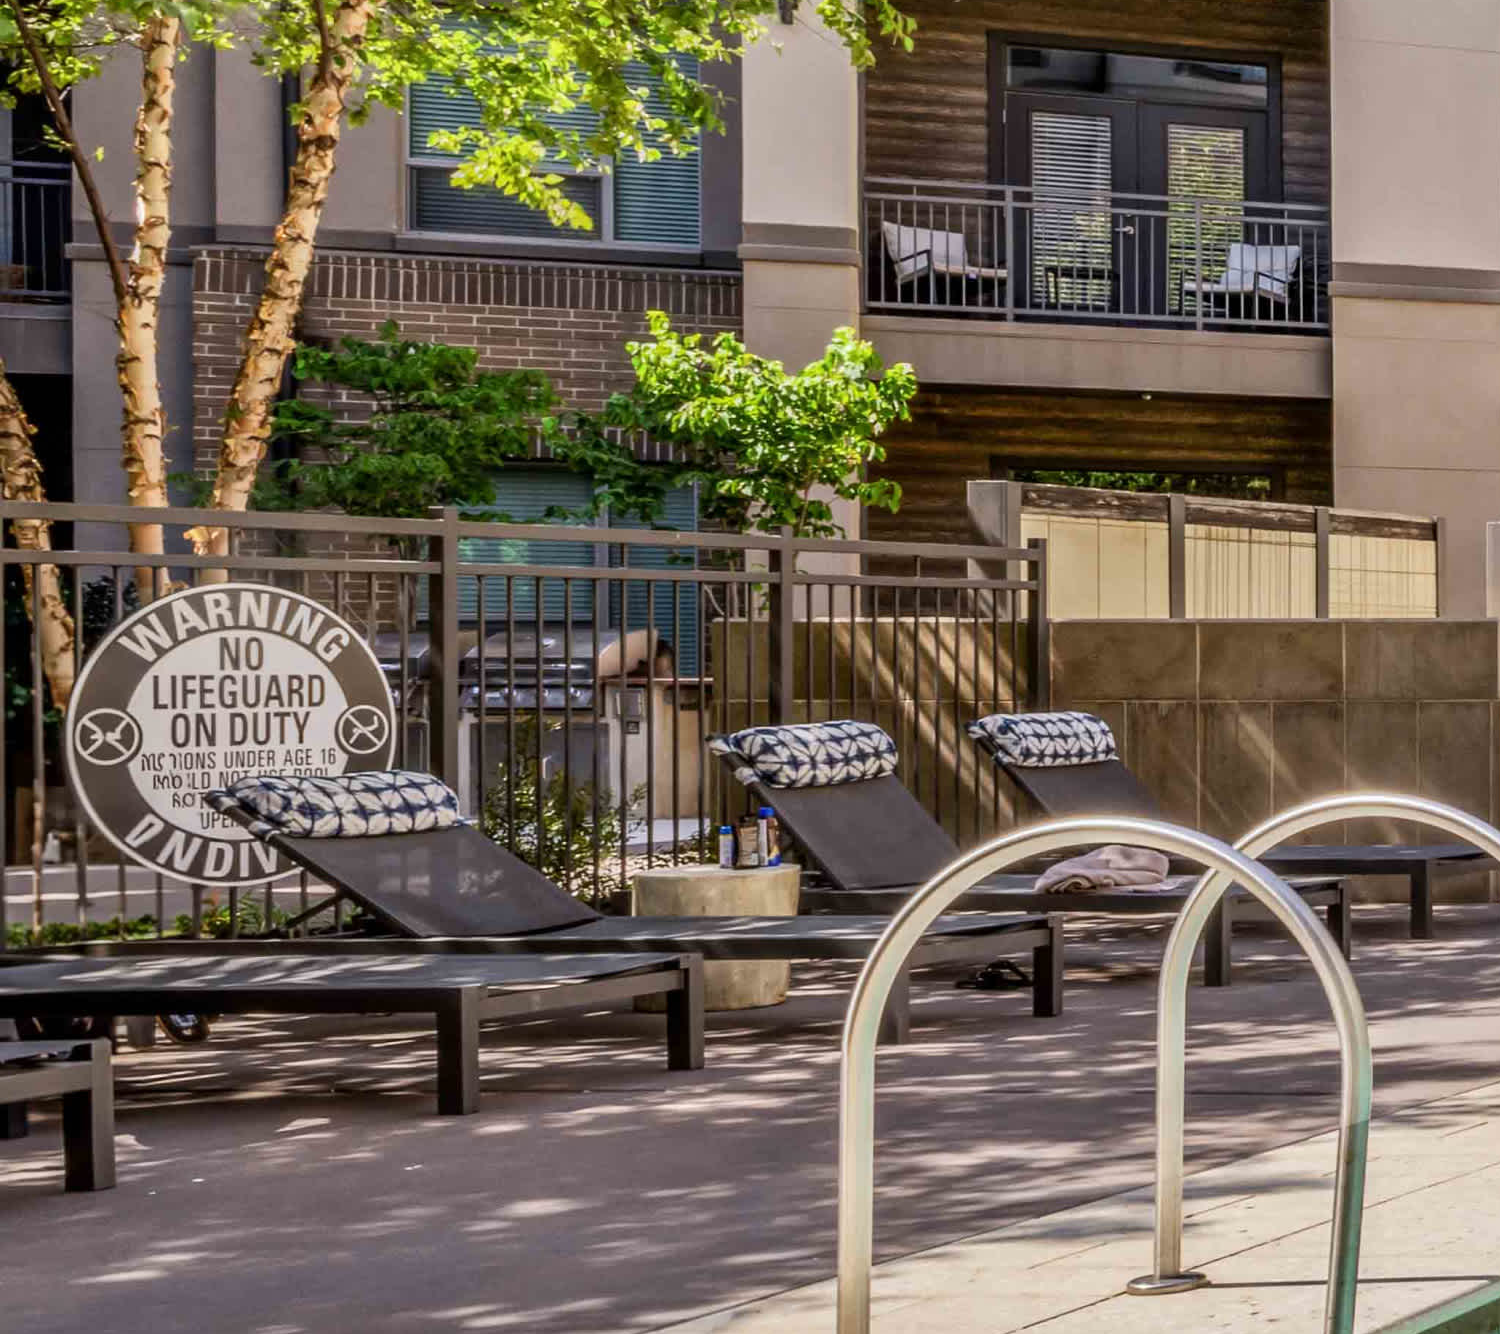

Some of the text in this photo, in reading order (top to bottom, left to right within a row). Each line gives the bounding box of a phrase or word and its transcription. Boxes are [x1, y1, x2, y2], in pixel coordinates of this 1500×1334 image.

[117, 591, 350, 663] WARNING
[219, 637, 264, 671] NO
[152, 674, 326, 710] LIFEGUARD
[171, 711, 311, 748] ON DUTY
[224, 750, 276, 769] UNDER
[283, 749, 312, 766] AGE
[321, 748, 336, 765] 16
